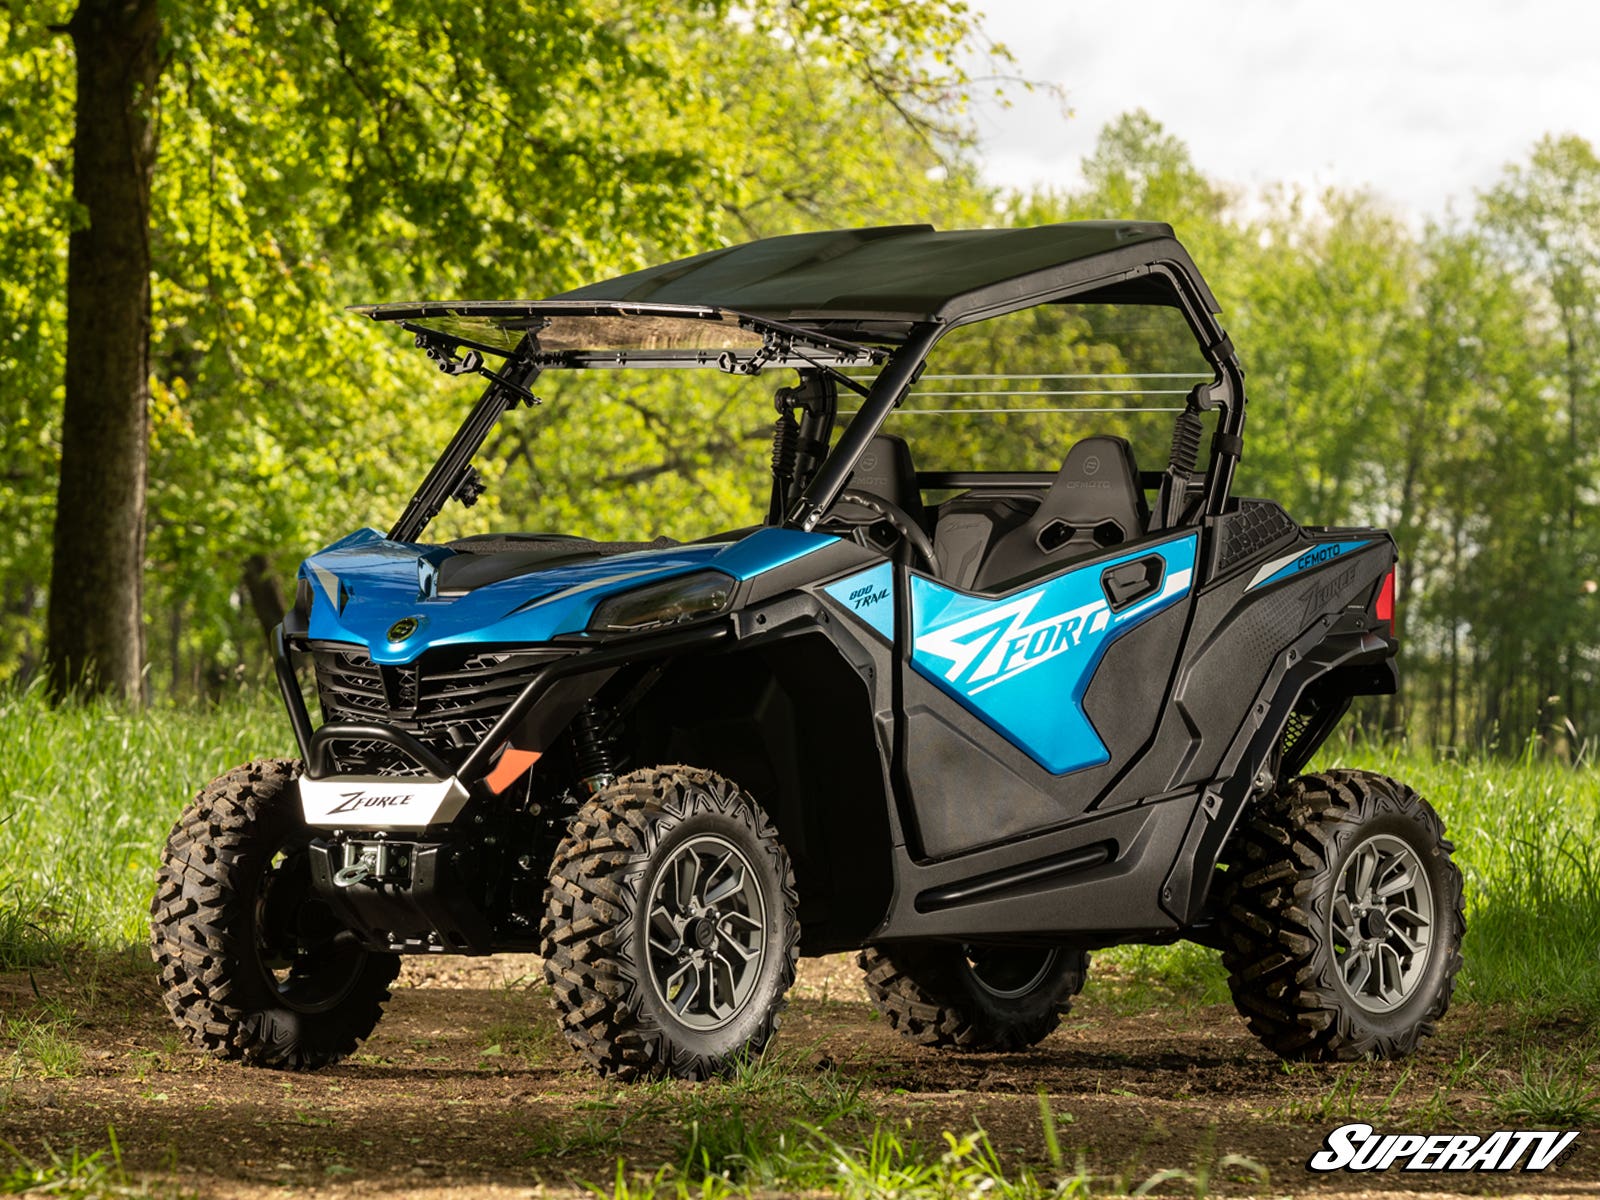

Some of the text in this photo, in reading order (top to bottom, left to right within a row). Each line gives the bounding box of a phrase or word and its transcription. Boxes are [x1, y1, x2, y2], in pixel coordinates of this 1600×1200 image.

[848, 476, 888, 488] FMOTO
[1297, 544, 1341, 571] CFMOTO
[849, 584, 874, 601] 800
[854, 588, 891, 610] TRAIL
[326, 790, 415, 816] ZFORCE
